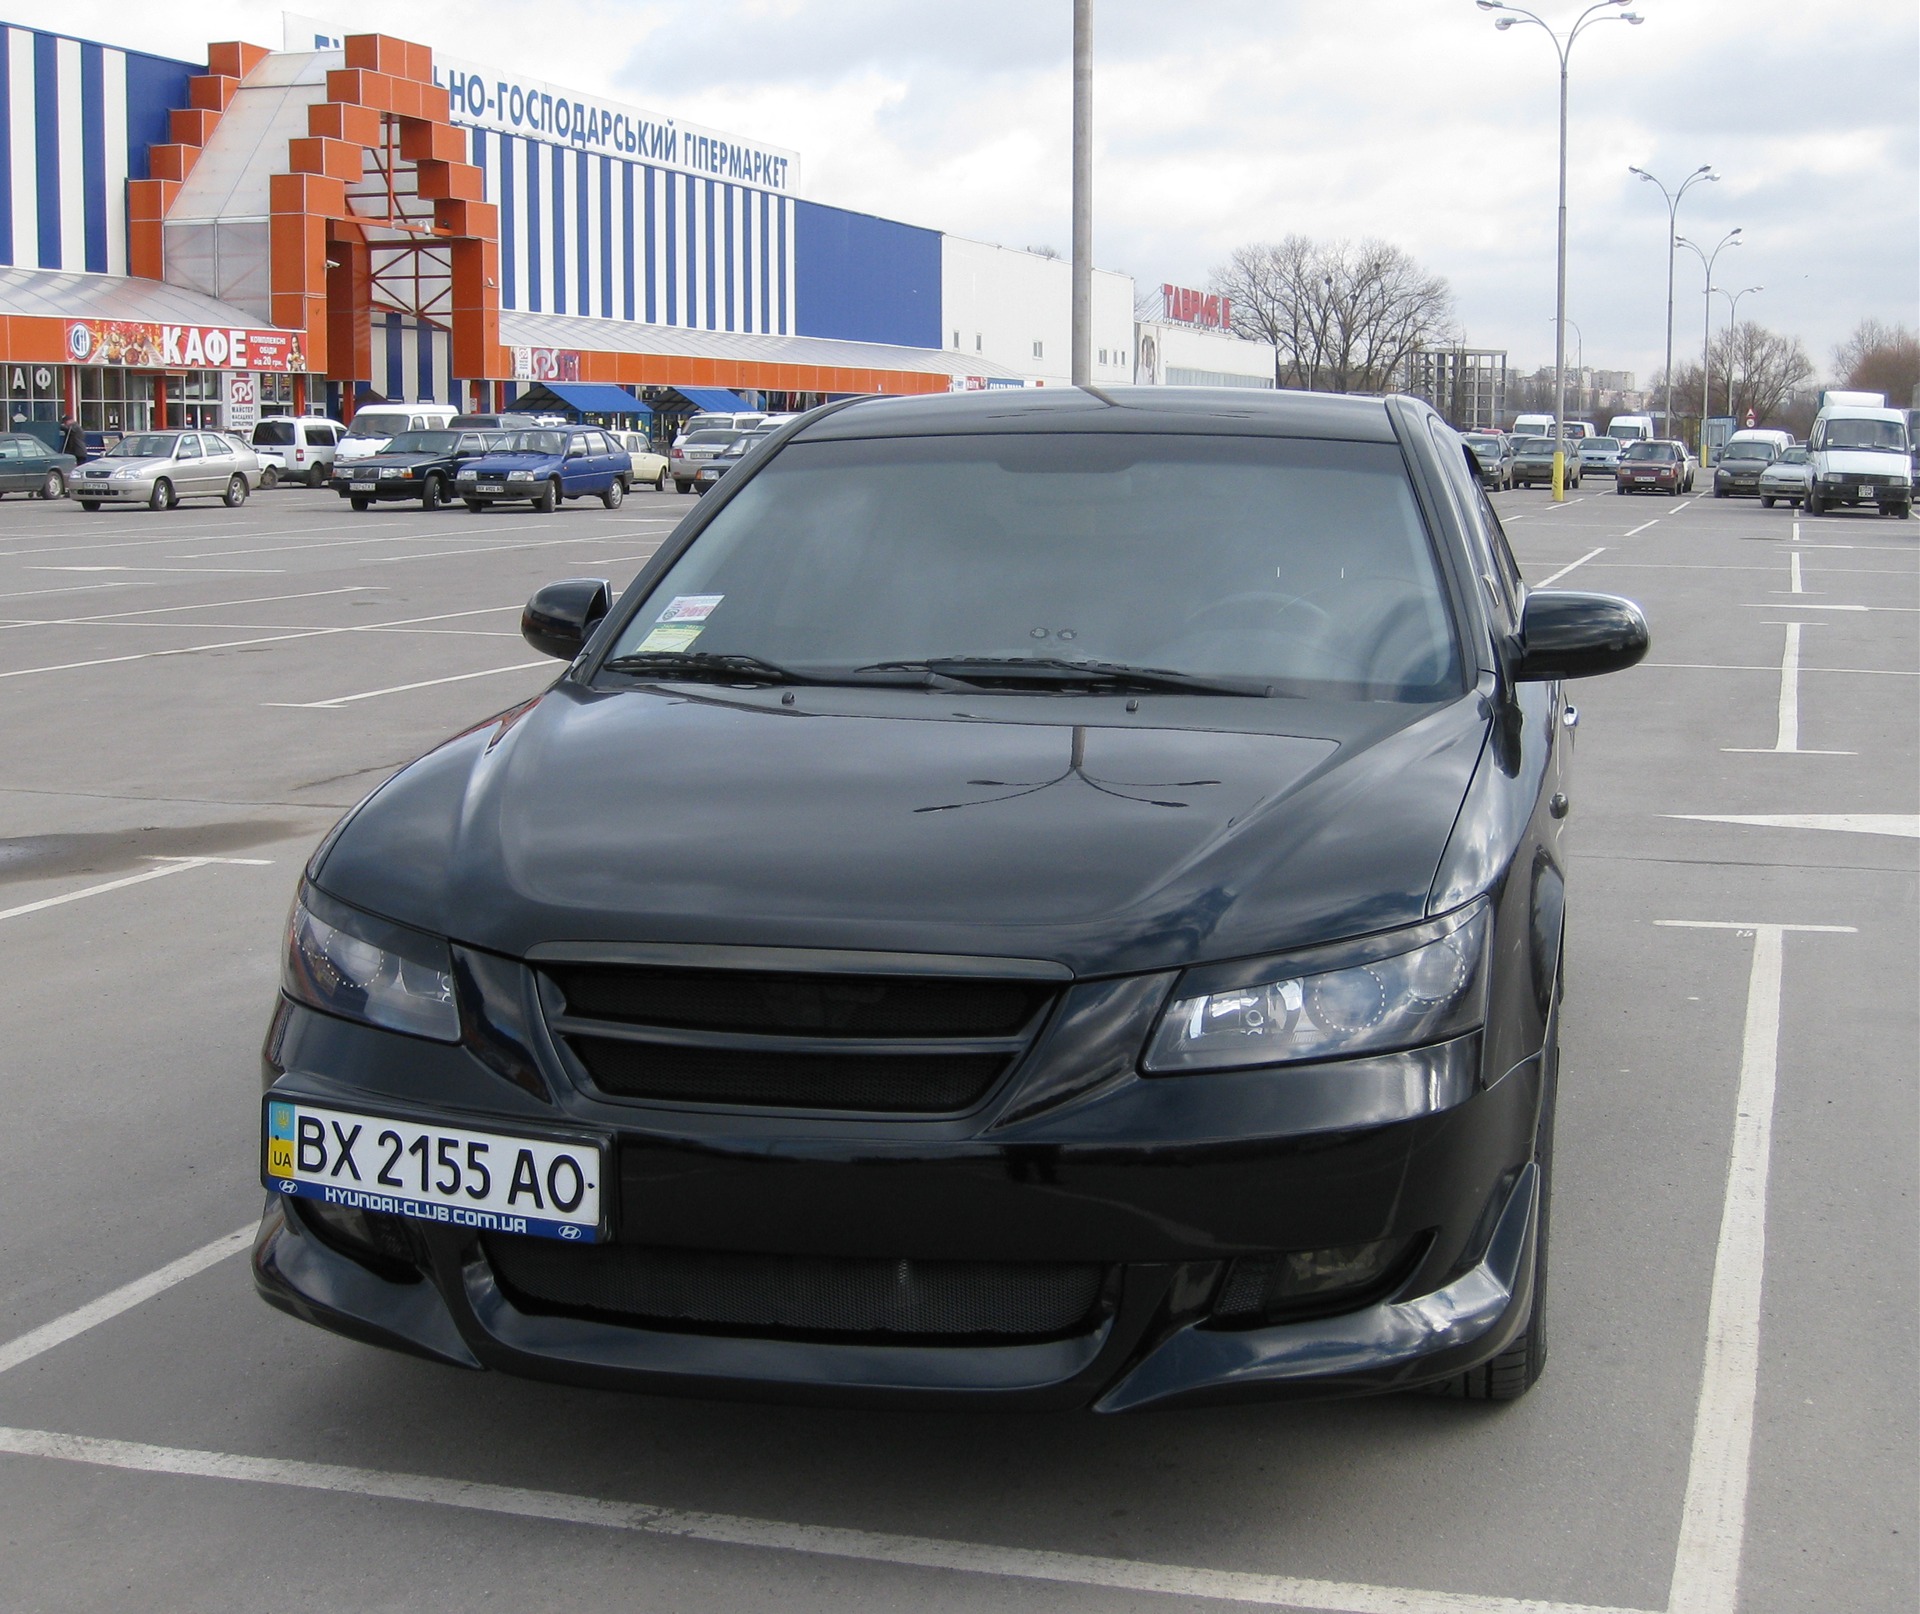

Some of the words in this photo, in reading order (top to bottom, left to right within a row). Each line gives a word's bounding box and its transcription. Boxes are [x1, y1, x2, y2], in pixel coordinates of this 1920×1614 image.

[163, 326, 247, 368] КАФЕ
[262, 356, 272, 366] 20
[12, 367, 27, 390] А
[35, 367, 52, 390] Ф
[231, 380, 254, 404] SPS
[272, 1150, 293, 1169] UA
[297, 1115, 363, 1181] BX
[377, 1129, 492, 1200] 2155
[507, 1148, 586, 1213] AO
